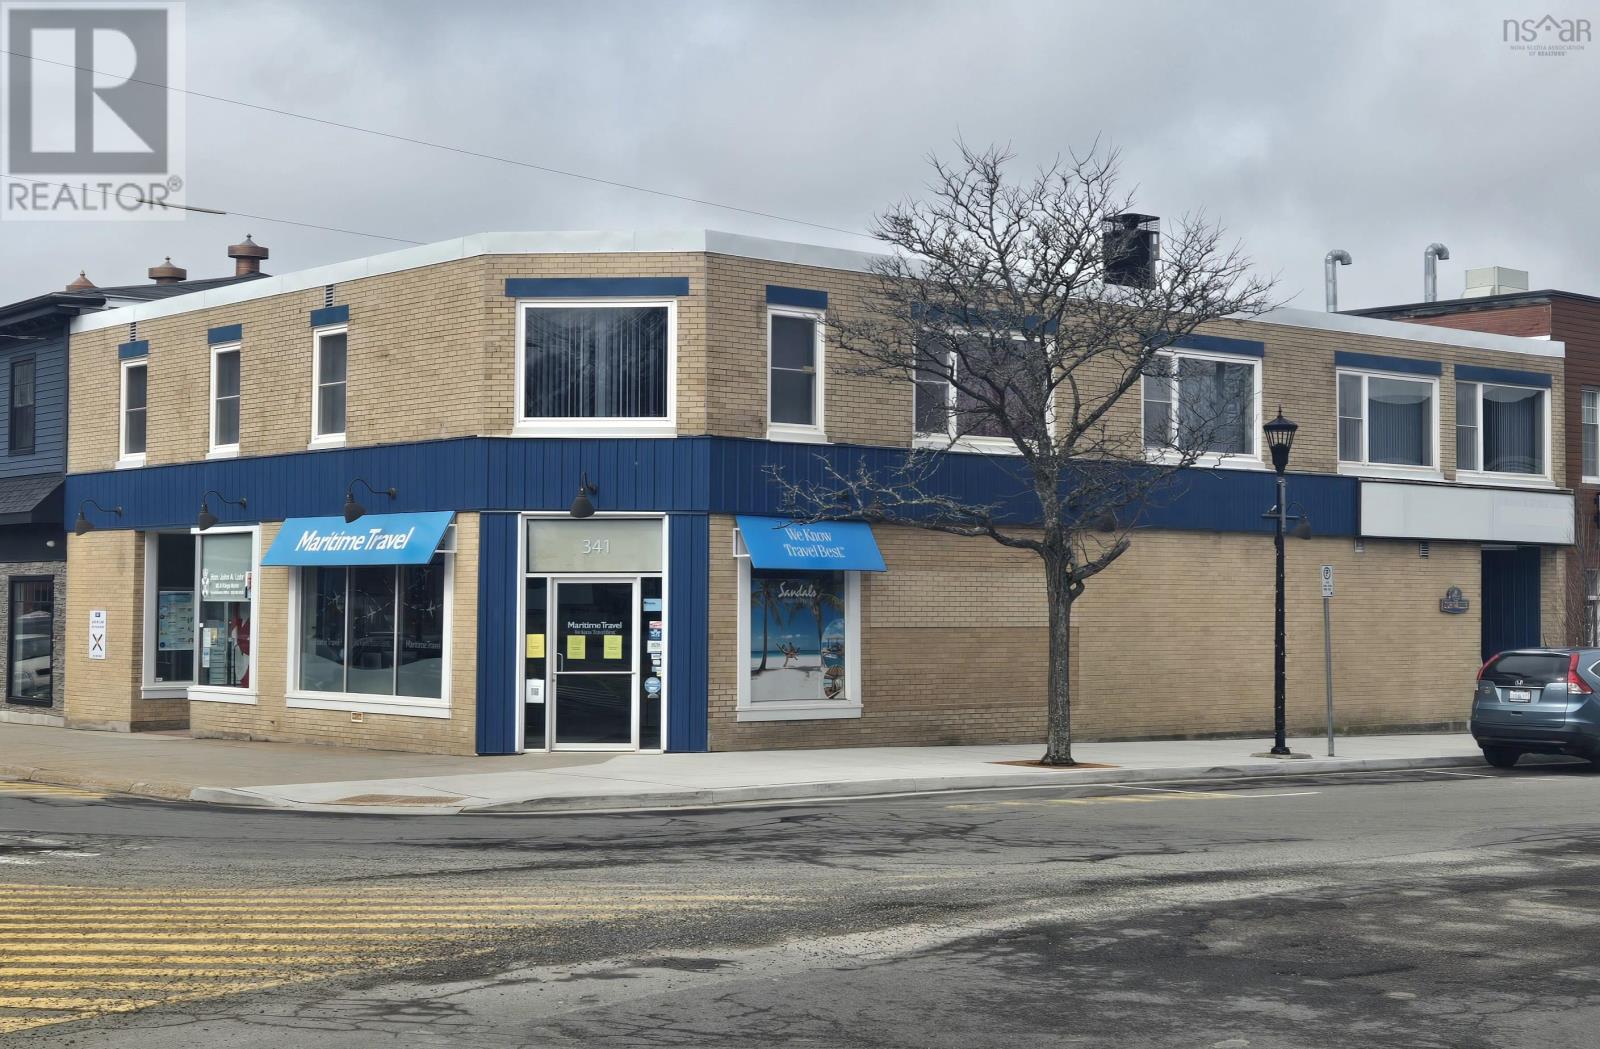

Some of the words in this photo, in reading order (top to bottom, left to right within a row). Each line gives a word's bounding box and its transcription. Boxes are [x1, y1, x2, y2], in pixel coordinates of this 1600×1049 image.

[295, 530, 367, 552] Maritime
[364, 526, 416, 551] Travel
[784, 526, 804, 541] We
[802, 528, 832, 543] Know
[582, 538, 611, 555] 341
[783, 543, 819, 558] Travel
[778, 581, 817, 598] Sandals
[567, 621, 601, 629] Maritime
[600, 621, 623, 629] Travel
